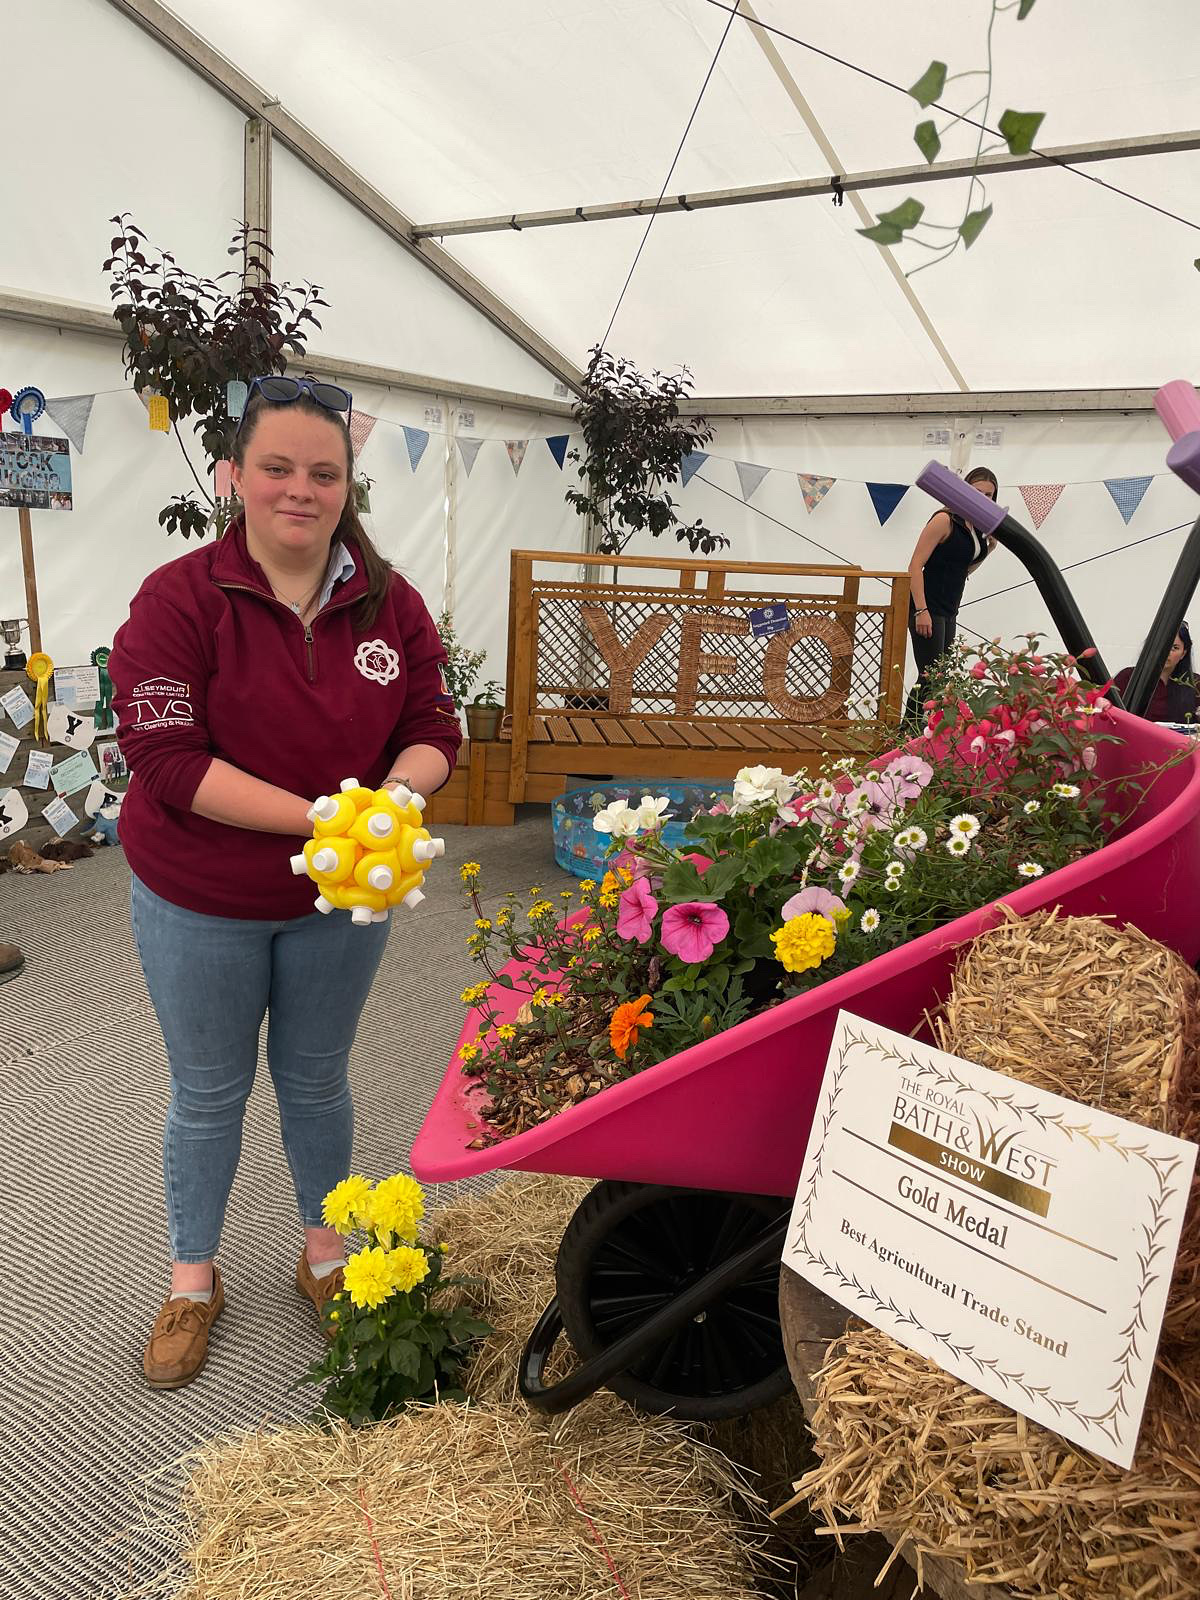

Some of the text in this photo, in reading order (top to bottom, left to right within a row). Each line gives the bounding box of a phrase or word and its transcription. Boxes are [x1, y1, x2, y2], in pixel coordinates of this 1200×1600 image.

[580, 606, 853, 723] YEO
[128, 700, 193, 723] TVS
[900, 1076, 965, 1116] THE ROYAL
[893, 1096, 1058, 1186] BATH & WEST
[939, 1151, 986, 1182] SHOW
[897, 1175, 1009, 1249] Gold Medal
[839, 1218, 1069, 1358] Best Agricultural Trade Stand
